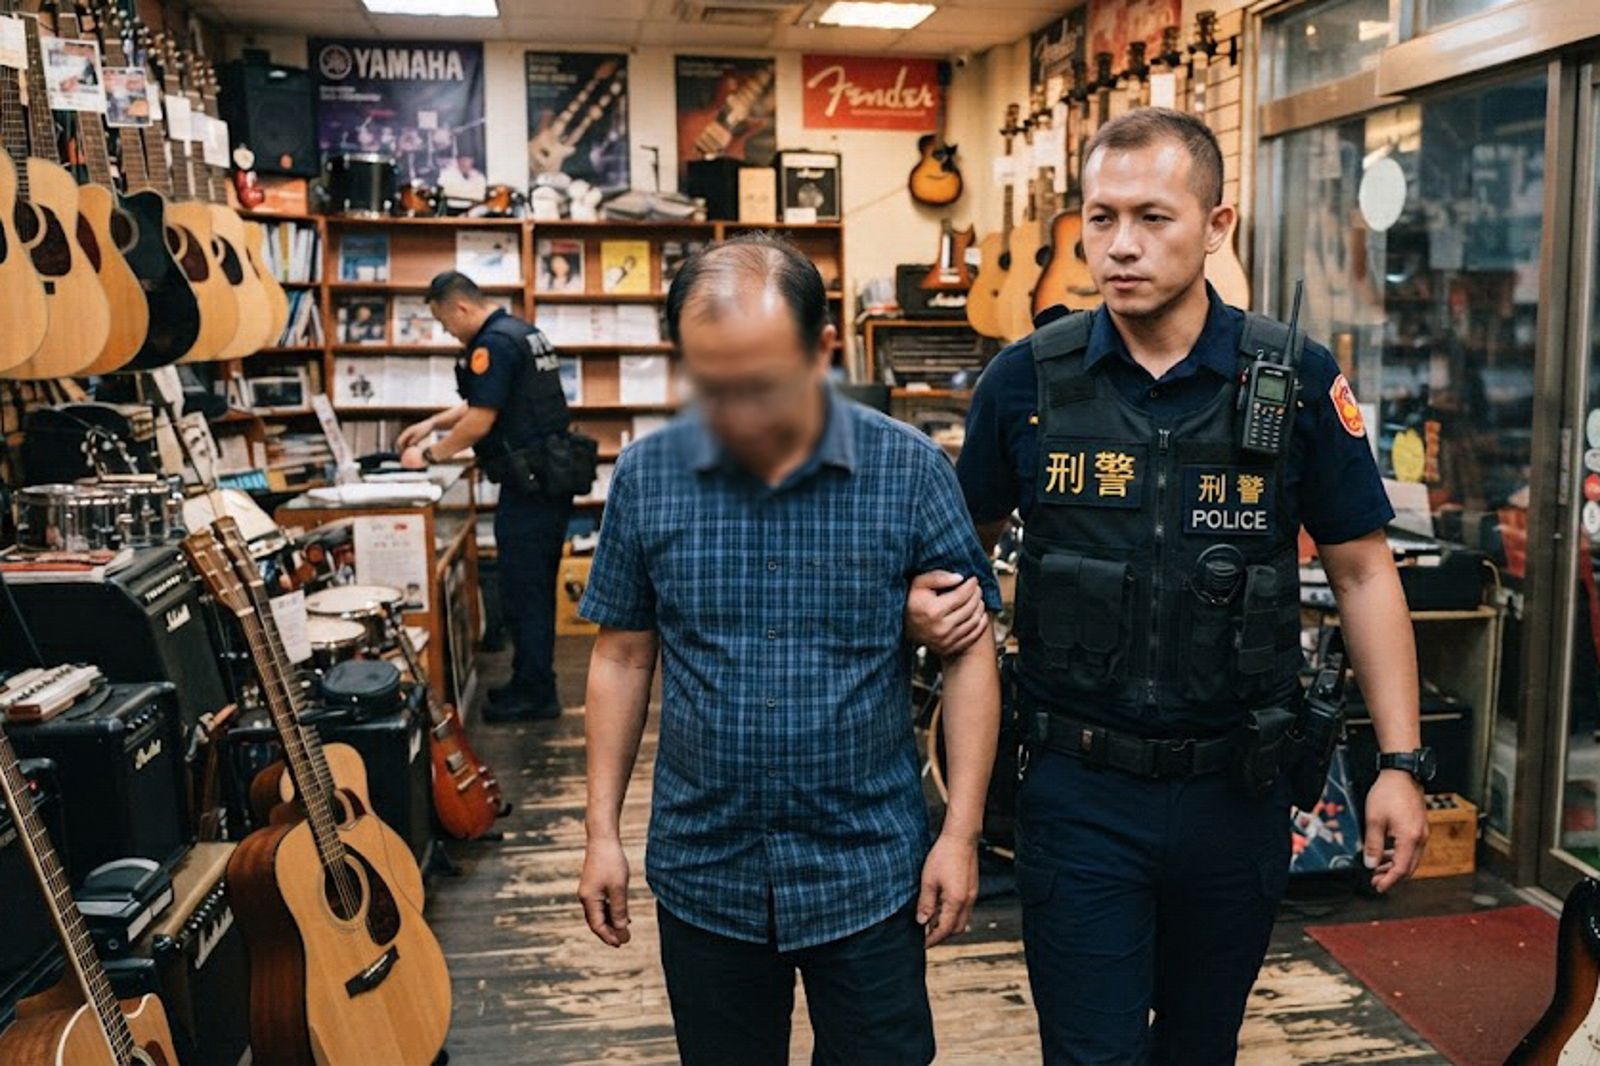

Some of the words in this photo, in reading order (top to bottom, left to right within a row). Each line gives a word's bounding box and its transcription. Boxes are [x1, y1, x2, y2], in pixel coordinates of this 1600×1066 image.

[352, 48, 464, 81] YAMAHA
[806, 65, 935, 118] Fender
[1045, 450, 1136, 497] 刑警
[1198, 473, 1265, 504] 刑警
[1191, 509, 1268, 530] POLICE
